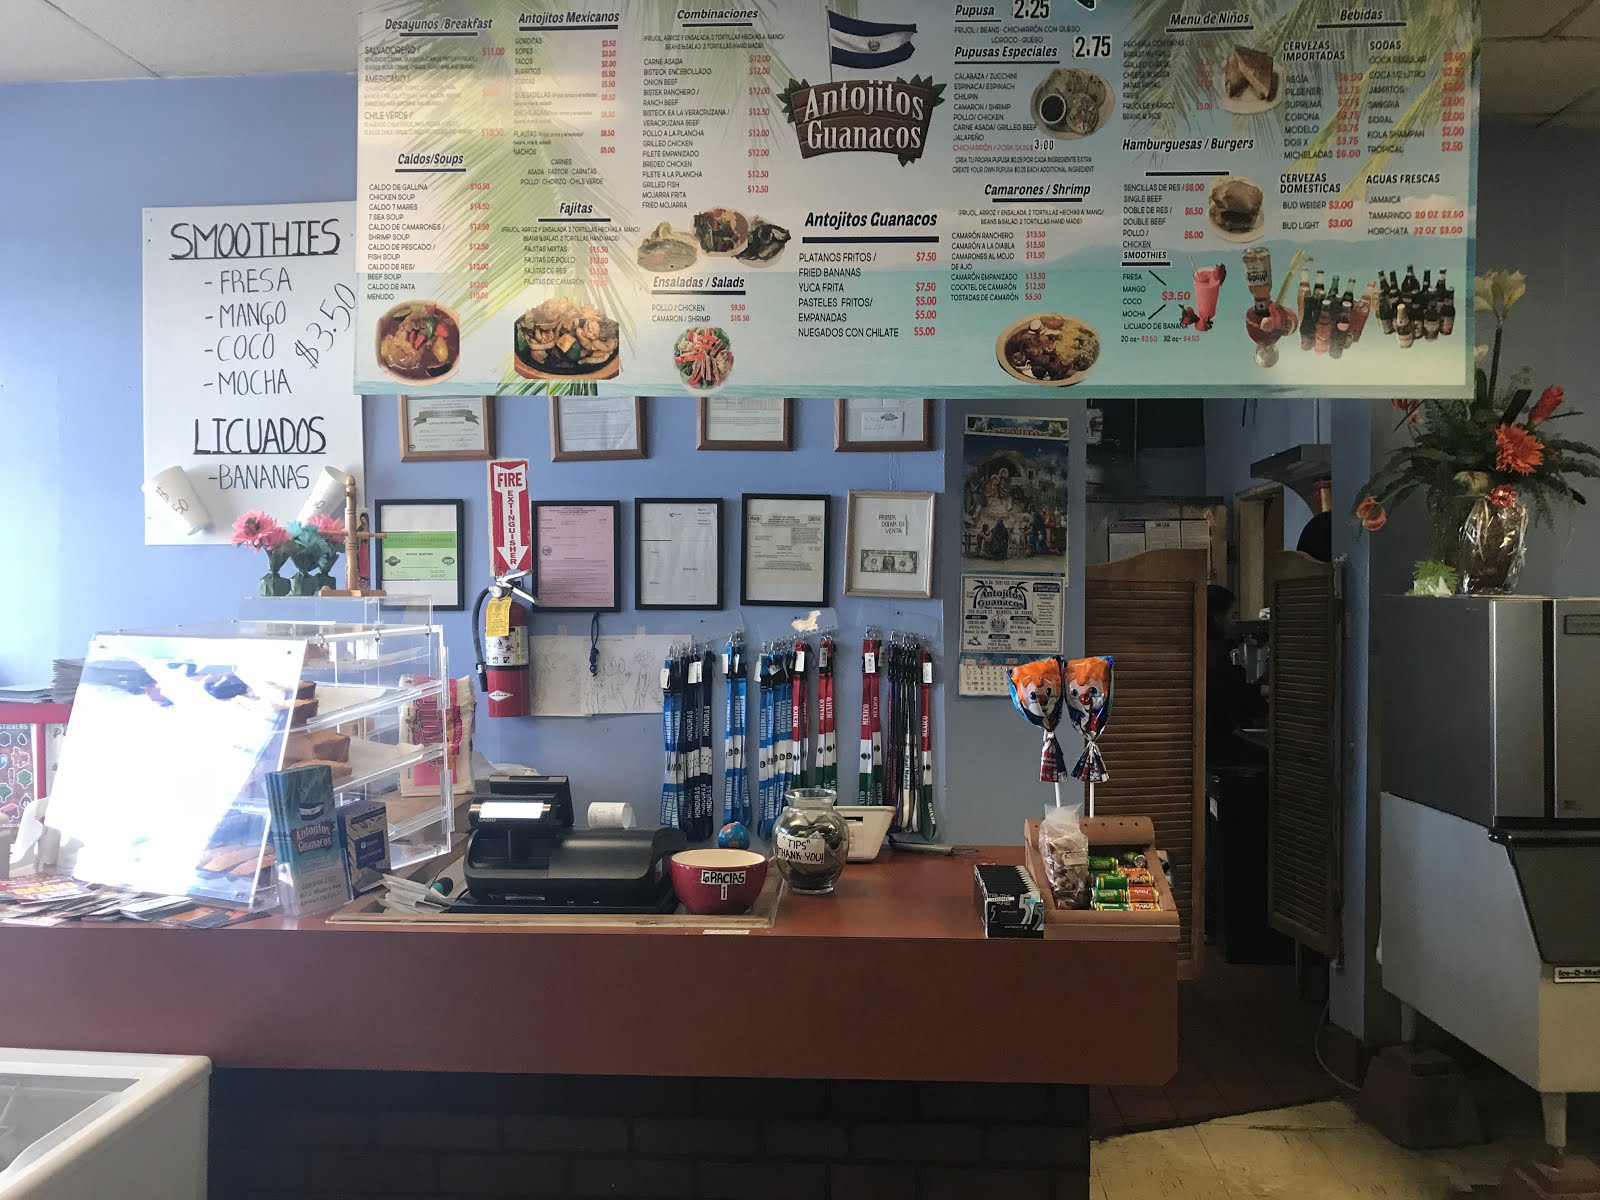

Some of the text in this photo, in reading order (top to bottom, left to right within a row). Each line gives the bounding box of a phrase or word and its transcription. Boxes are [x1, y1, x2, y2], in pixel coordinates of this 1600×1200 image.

[677, 9, 758, 19] Combinaciones
[955, 5, 994, 18] Pupusa
[1014, 0, 1049, 18] 2.25
[519, 12, 619, 24] Antojitos Mexicanos
[1170, 12, 1249, 25] Menu de Niños
[1340, 10, 1383, 21] Bebidas
[385, 18, 439, 32] Desayunos
[1075, 36, 1111, 57] 2.75
[1283, 41, 1329, 51] CERVEZAS
[1370, 41, 1401, 50] SODAS
[955, 45, 1057, 58] Pupusas Especiales
[1283, 51, 1345, 61] IMPORTADAS
[644, 78, 663, 86] ONION
[803, 80, 924, 123] Antojitos
[807, 120, 921, 149] Guanacos
[1285, 126, 1319, 134] MODELO
[1123, 138, 1254, 152] Hamburguesas Burgers
[398, 154, 463, 166] Caldos/Soups
[1280, 173, 1326, 183] CERVEZAS
[1366, 174, 1440, 184] AGUAS FRESCAS
[985, 183, 1090, 197] Camarones Shrimp
[1280, 183, 1341, 194] DOMESTICAS
[560, 202, 593, 216] Fajitas
[1300, 201, 1326, 209] WEISER
[1328, 201, 1353, 209] $3.00
[805, 211, 937, 230] Antojitos Guanacos
[952, 230, 981, 239] CAMARÓN
[1368, 227, 1408, 235] HORCHATA
[170, 218, 340, 258] SMOOTHIES
[799, 252, 870, 262] PLATANOS FRITOS
[916, 252, 936, 262] $7.50
[799, 268, 861, 277] FRIED BANANAS
[220, 267, 292, 294] FRESA
[653, 276, 744, 288] Ensaladas Salads
[799, 283, 844, 292] YUCA FRITA
[916, 297, 936, 306] $5.00
[1162, 291, 1190, 301] $3.50
[652, 304, 705, 312] POLLO CHICKEN
[731, 304, 745, 312] $9.50
[799, 298, 837, 308] PASTELES
[220, 300, 286, 332] MANGO
[688, 315, 710, 323] SHRIMP
[799, 313, 847, 323] EMPANADAS
[294, 283, 356, 369] $3.50
[914, 327, 935, 336] $5.00
[799, 328, 898, 338] NUEGADOS CON CHILATE
[217, 333, 274, 362] COCO
[218, 368, 292, 395] MOCHA
[194, 416, 326, 454] LICUADOS
[497, 472, 522, 487] FIRE
[507, 489, 517, 565] EXTINGUISHER
[805, 852, 824, 863] YOU!
[702, 872, 745, 883] GRACIAS
